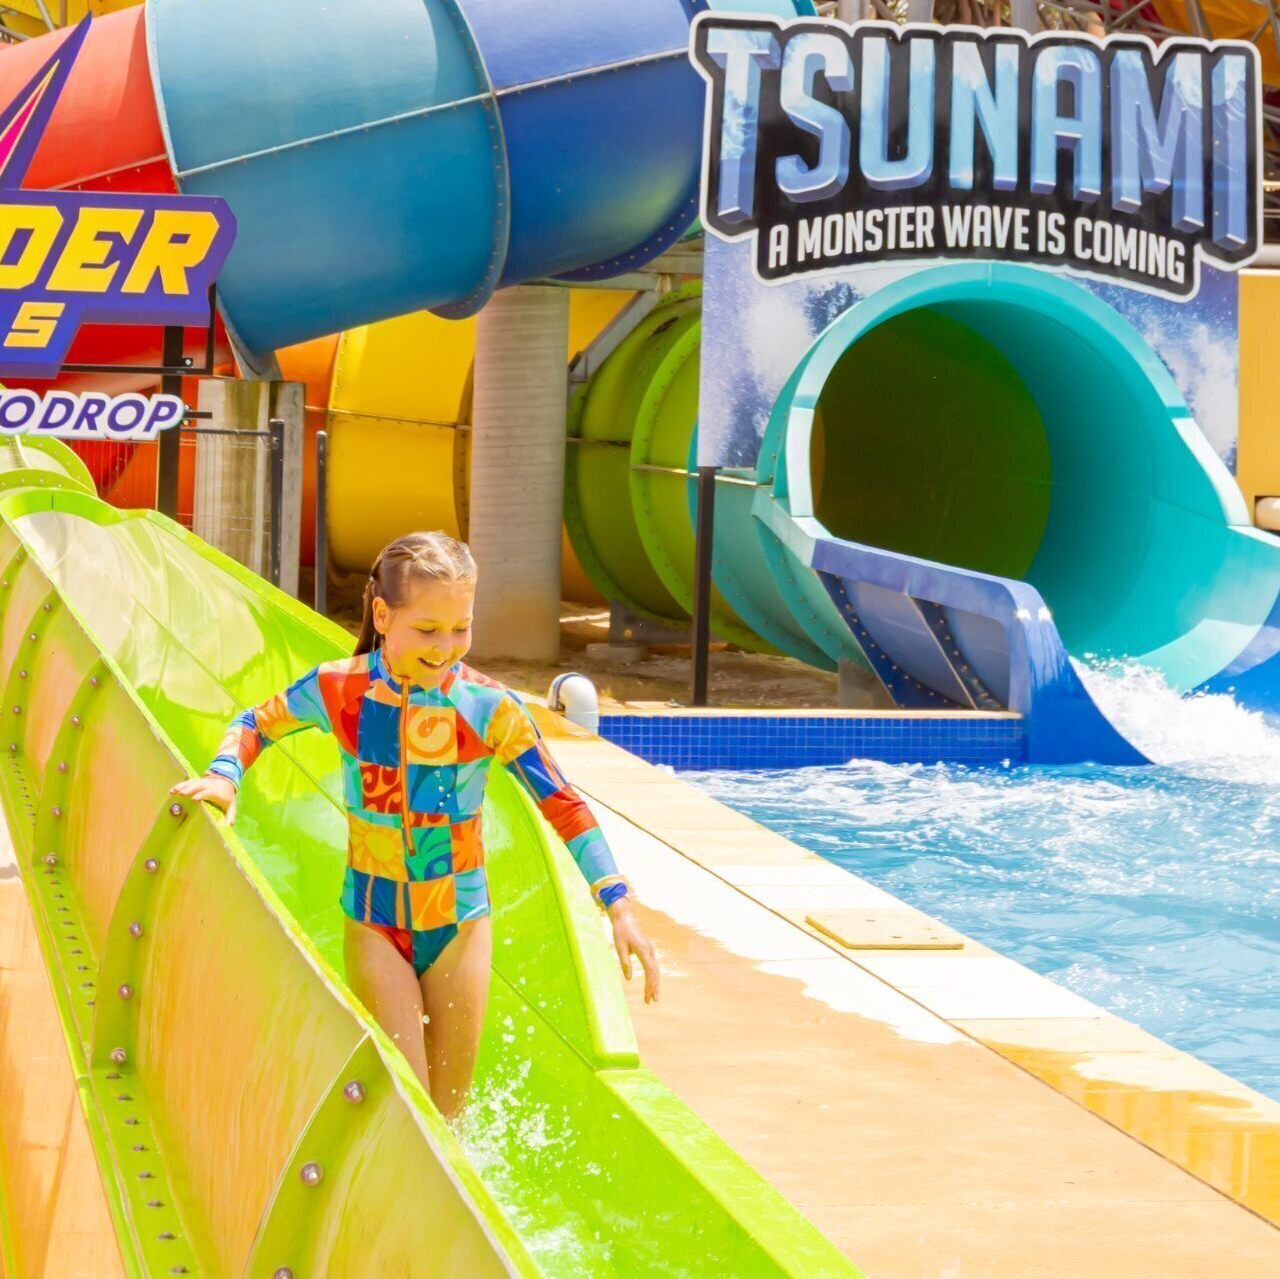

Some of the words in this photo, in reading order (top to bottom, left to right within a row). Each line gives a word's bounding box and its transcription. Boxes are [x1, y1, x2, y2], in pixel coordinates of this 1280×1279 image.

[708, 29, 1247, 250] TSUNAMI
[768, 224, 788, 268] A
[797, 205, 935, 261] MONSTER
[942, 206, 1029, 250] WAVE
[1038, 211, 1066, 255] IS
[1074, 217, 1185, 284] COMING
[37, 396, 179, 432] DROP
